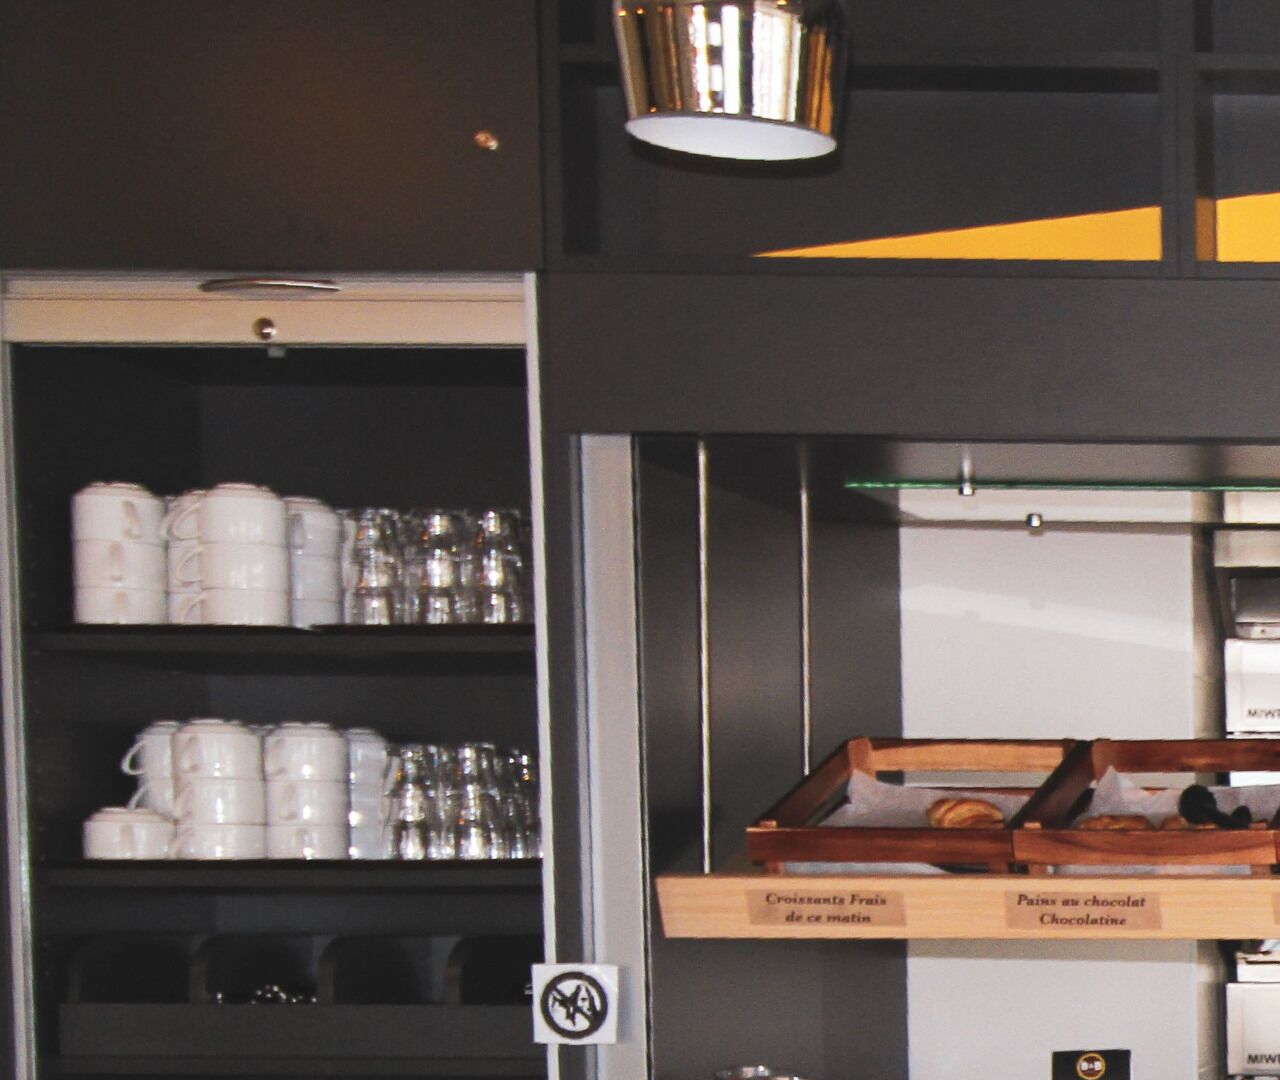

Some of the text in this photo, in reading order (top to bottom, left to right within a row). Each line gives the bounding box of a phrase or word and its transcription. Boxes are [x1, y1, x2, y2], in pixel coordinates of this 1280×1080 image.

[765, 892, 887, 906] Croissants Frais
[1017, 893, 1147, 908] Pains au chocolat
[785, 911, 872, 923] de ce matin
[1039, 912, 1127, 926] Chocolatine
